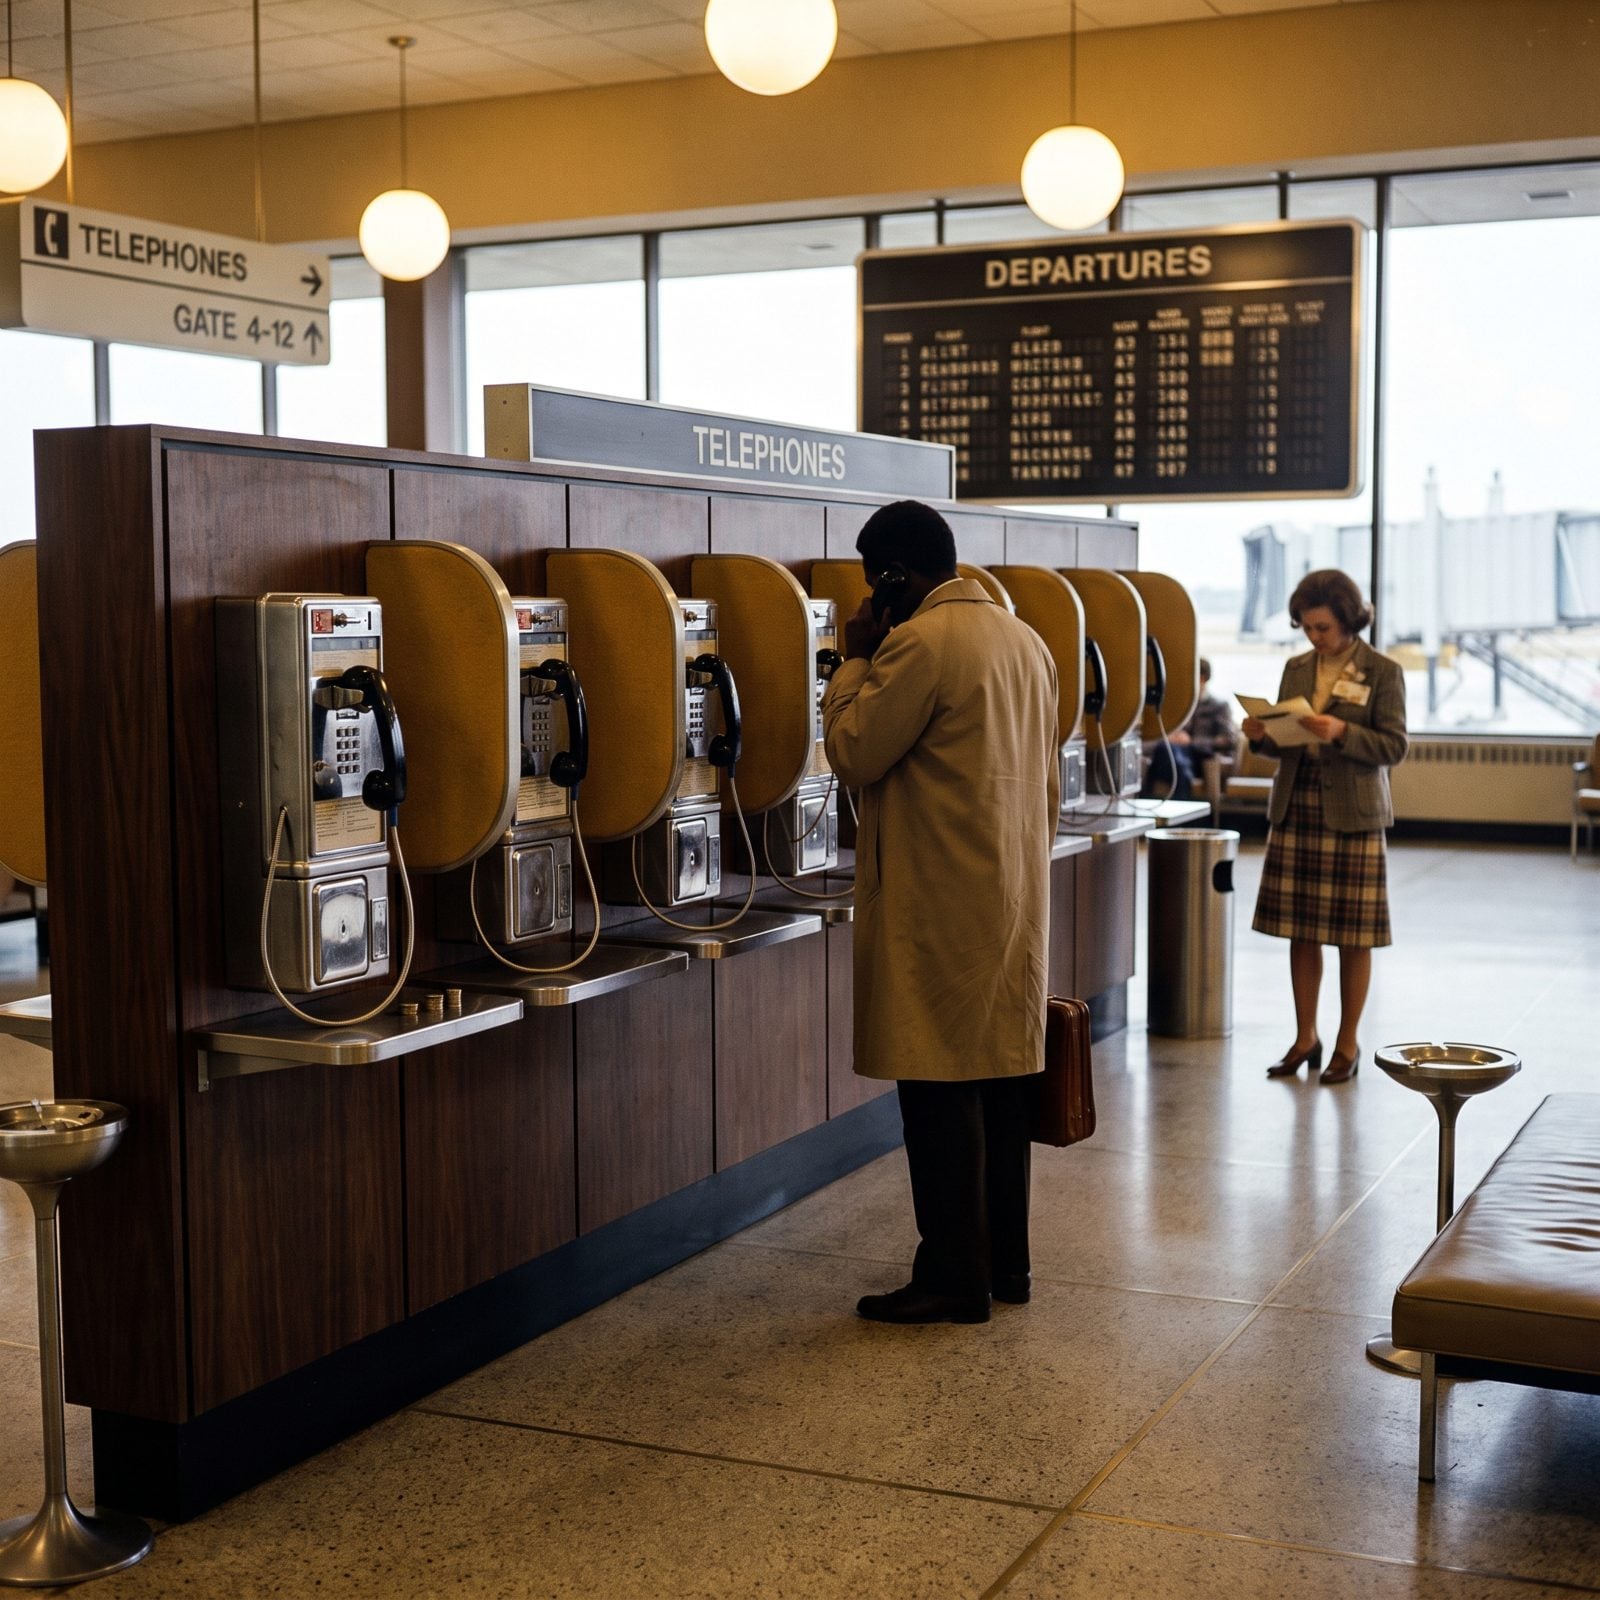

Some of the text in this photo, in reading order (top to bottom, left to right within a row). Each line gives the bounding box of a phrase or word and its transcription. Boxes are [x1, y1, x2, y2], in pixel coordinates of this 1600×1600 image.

[79, 223, 247, 281] TELEPHONES
[985, 245, 1212, 289] DEPARTURES
[173, 304, 294, 349] GATE 4-12
[692, 425, 845, 481] TELEPHONES
